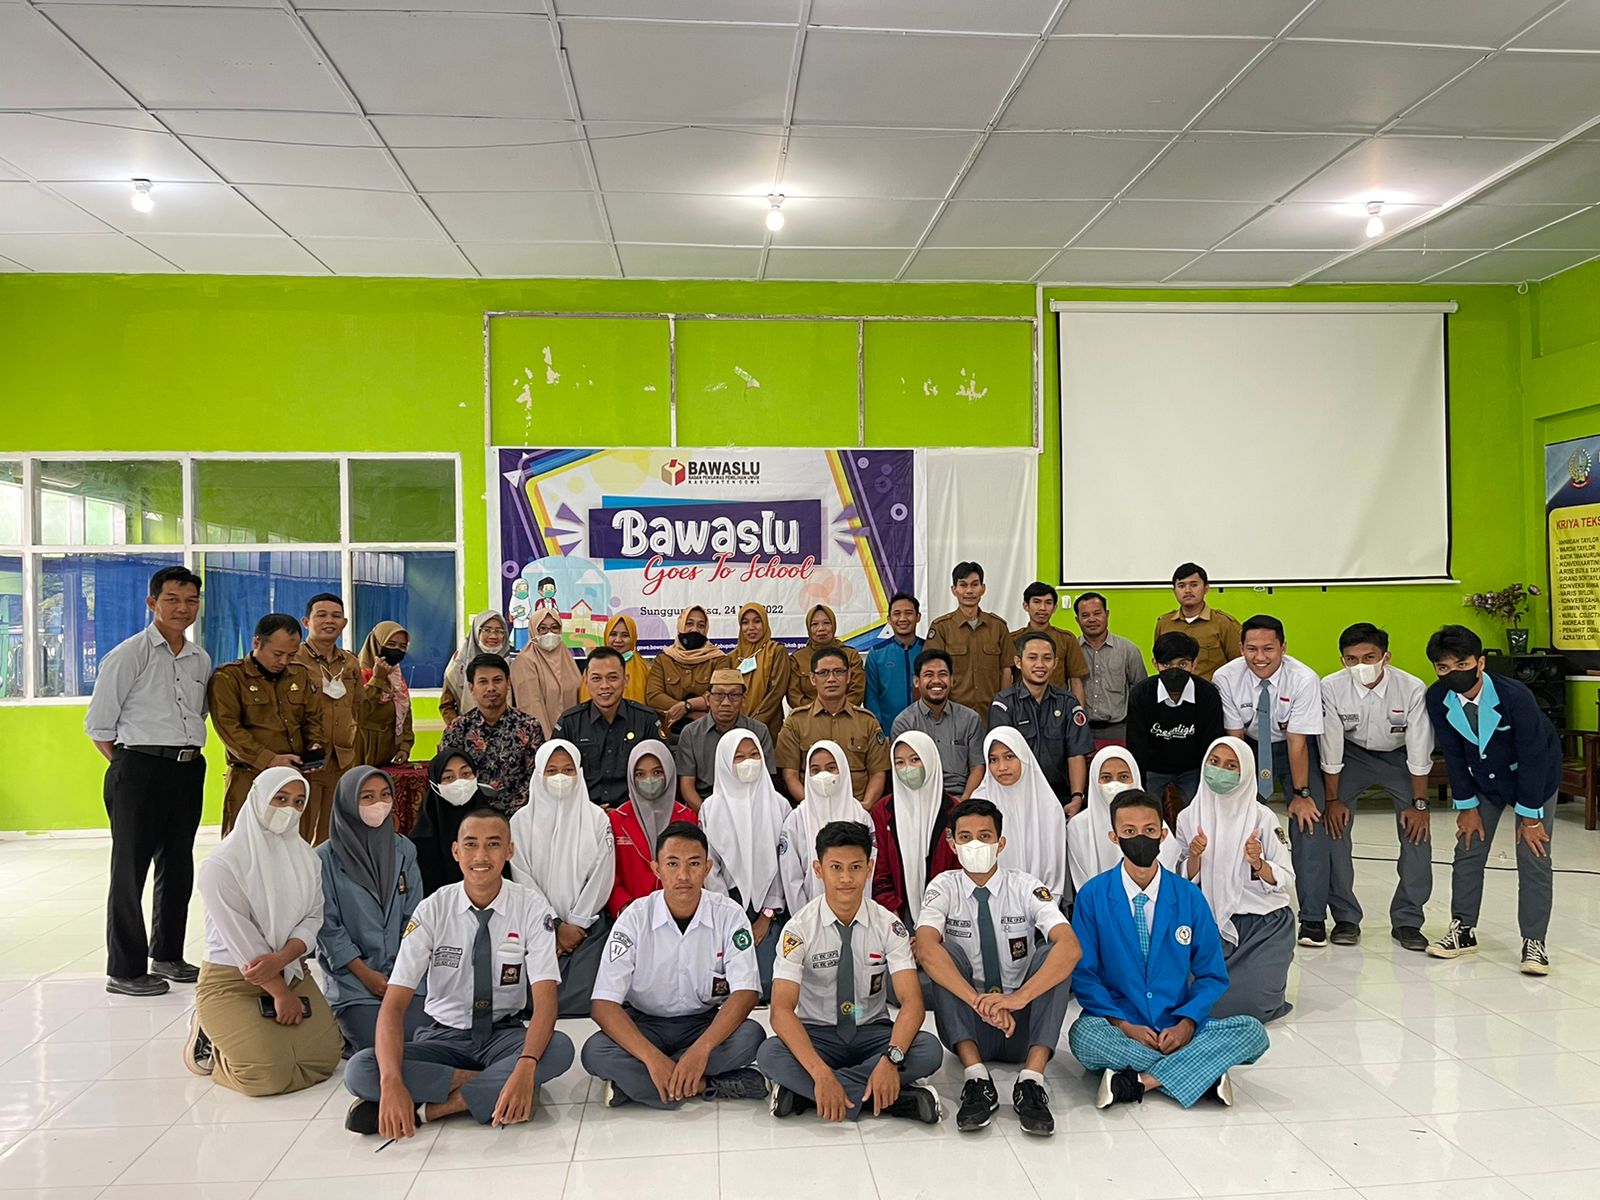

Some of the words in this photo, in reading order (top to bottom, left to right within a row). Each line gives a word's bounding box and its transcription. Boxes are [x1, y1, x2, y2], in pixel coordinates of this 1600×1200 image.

[688, 461, 760, 475] BAWASLU
[1556, 518, 1579, 530] KRIYA
[612, 509, 800, 558] Bawaslu
[642, 554, 703, 596] Goes
[707, 552, 736, 583] To
[740, 554, 816, 583] School
[724, 605, 736, 614] 24
[763, 604, 784, 614] 022
